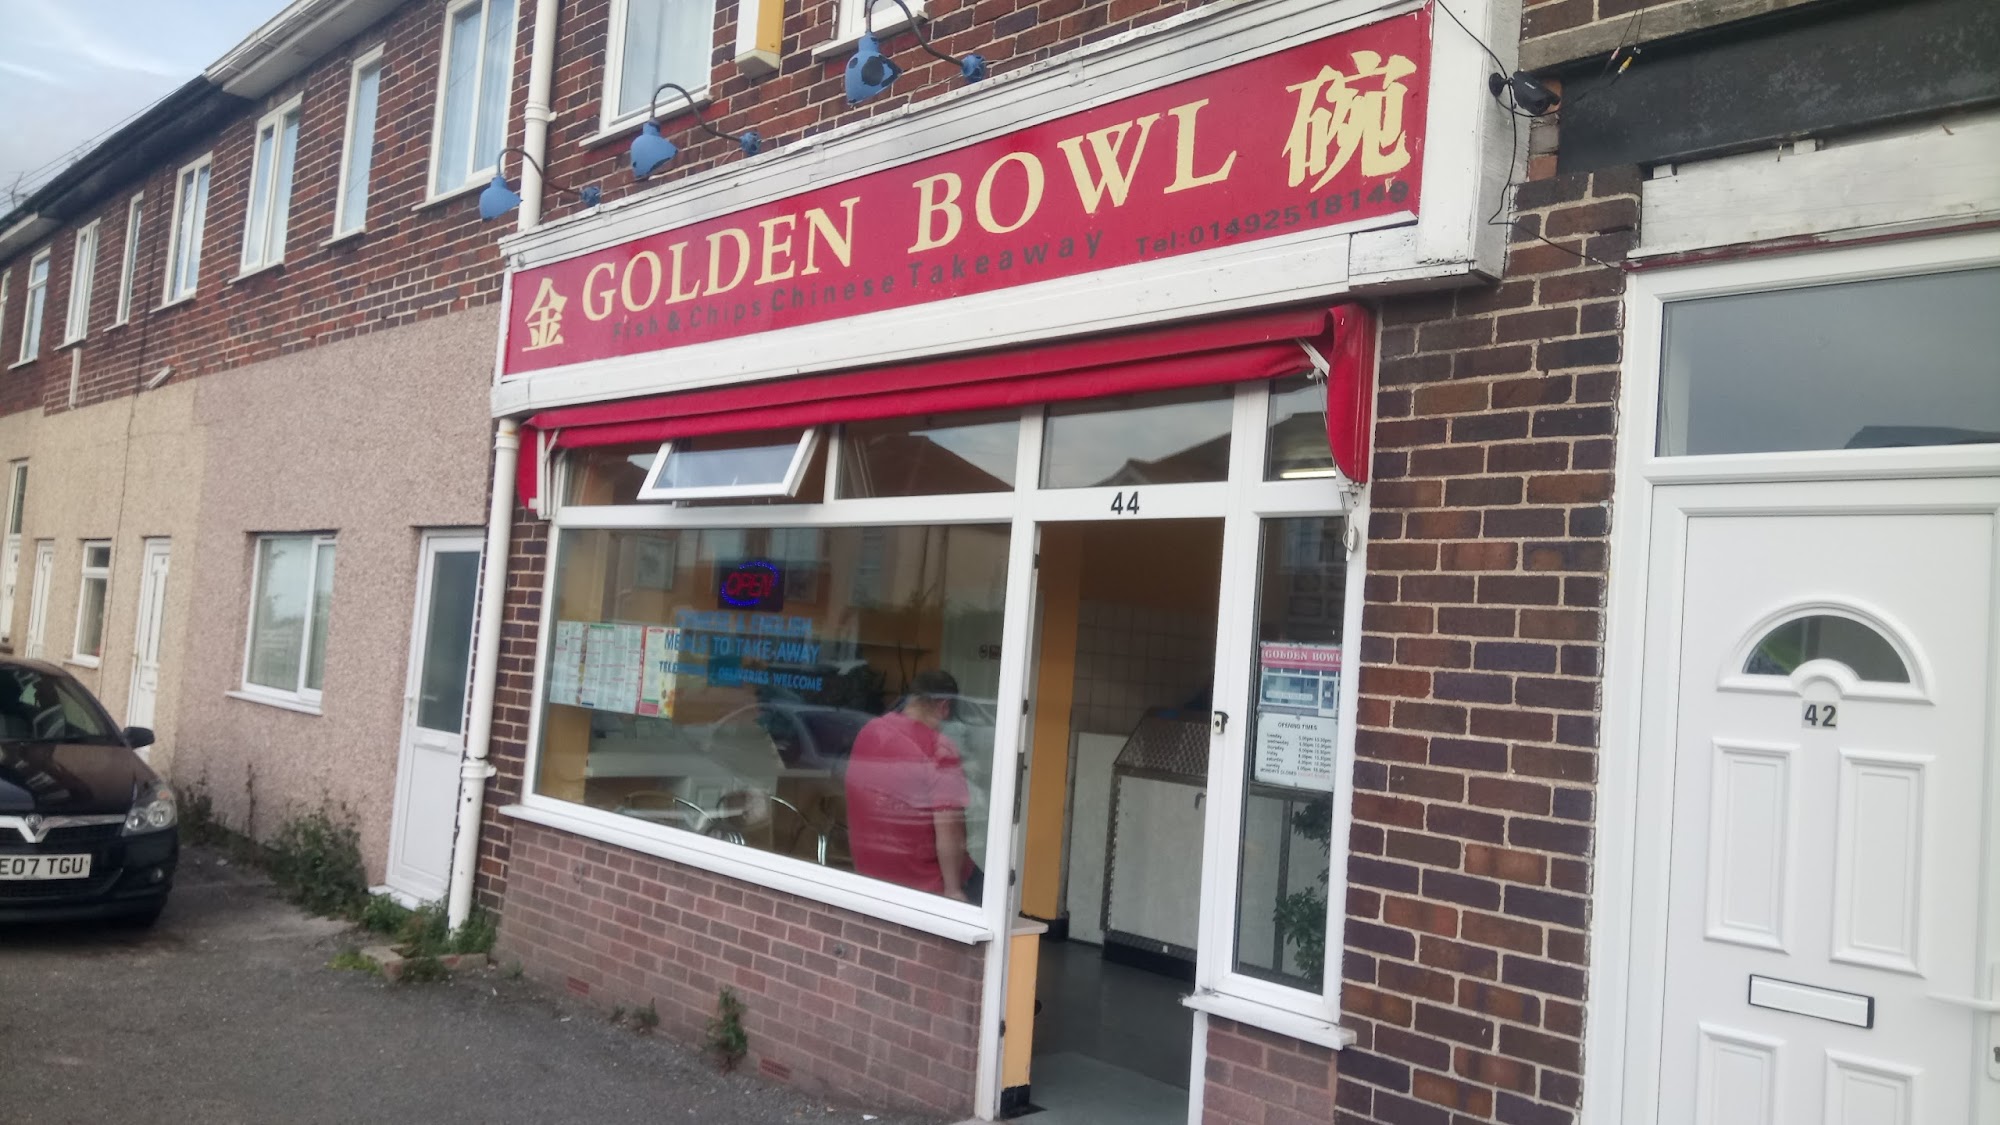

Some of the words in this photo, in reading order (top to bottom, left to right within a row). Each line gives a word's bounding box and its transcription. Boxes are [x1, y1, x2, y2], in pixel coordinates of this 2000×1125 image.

[1281, 50, 1417, 193] 碗
[582, 196, 860, 321] GOLDEN
[907, 98, 1237, 254] BOWL
[612, 315, 659, 341] Fish
[668, 310, 681, 332] &
[690, 300, 761, 327] Chips
[772, 272, 894, 312] Chinese
[908, 230, 1104, 288] Takeaway
[522, 277, 568, 352] 金
[1110, 491, 1140, 515] 44
[725, 572, 774, 598] OPEN
[713, 636, 728, 657] TO
[1264, 649, 1308, 660] GOLDEN
[773, 672, 824, 691] WELCOME
[1804, 704, 1836, 727] 42
[47, 856, 84, 875] TGU
